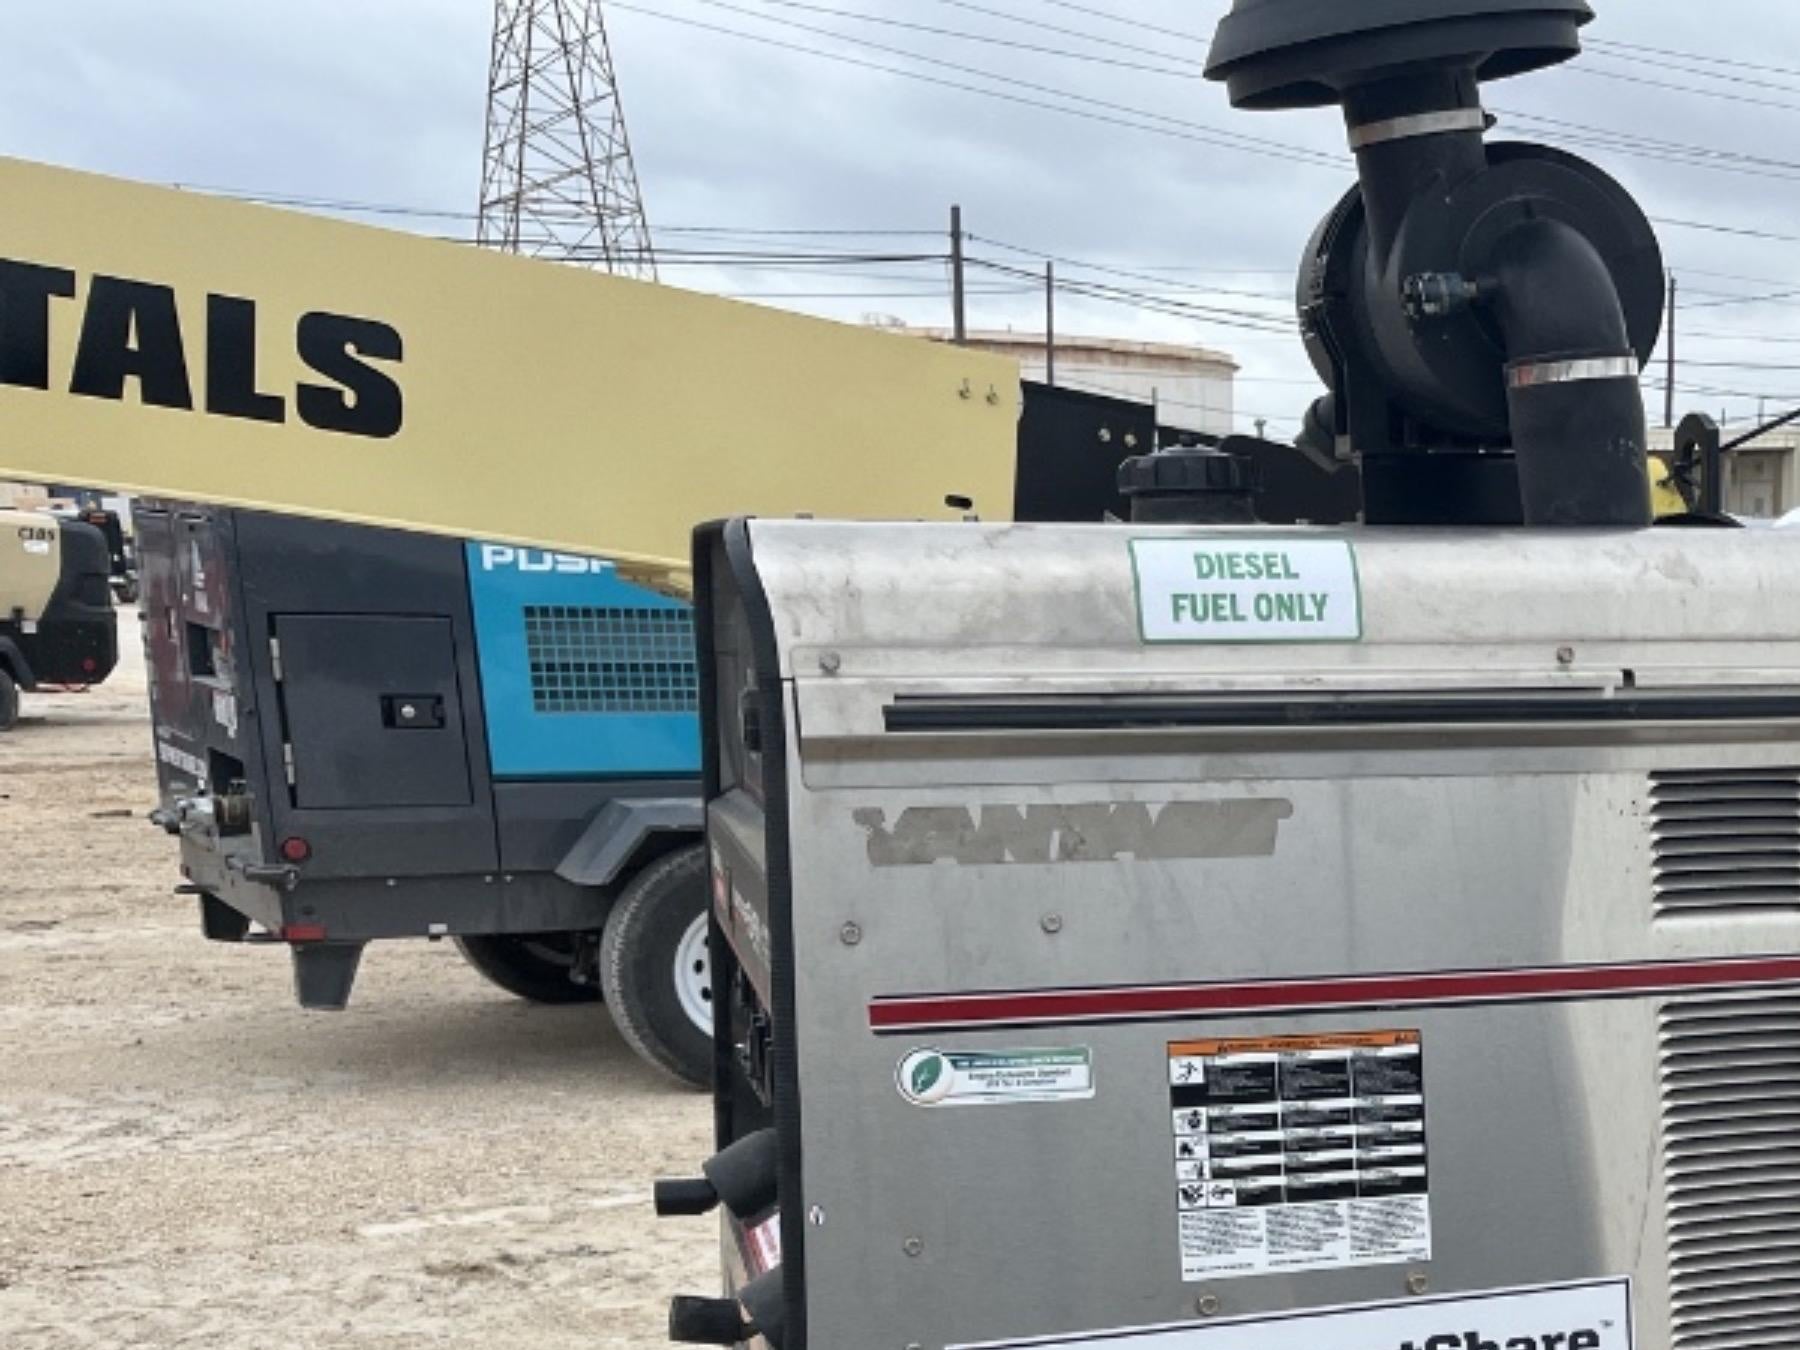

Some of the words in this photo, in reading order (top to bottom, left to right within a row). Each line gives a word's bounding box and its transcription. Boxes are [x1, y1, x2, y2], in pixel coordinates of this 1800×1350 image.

[0, 257, 403, 439] TALS
[1193, 552, 1301, 580] DIESEL
[1170, 593, 1248, 623] FUEL
[1253, 592, 1329, 622] ONLY
